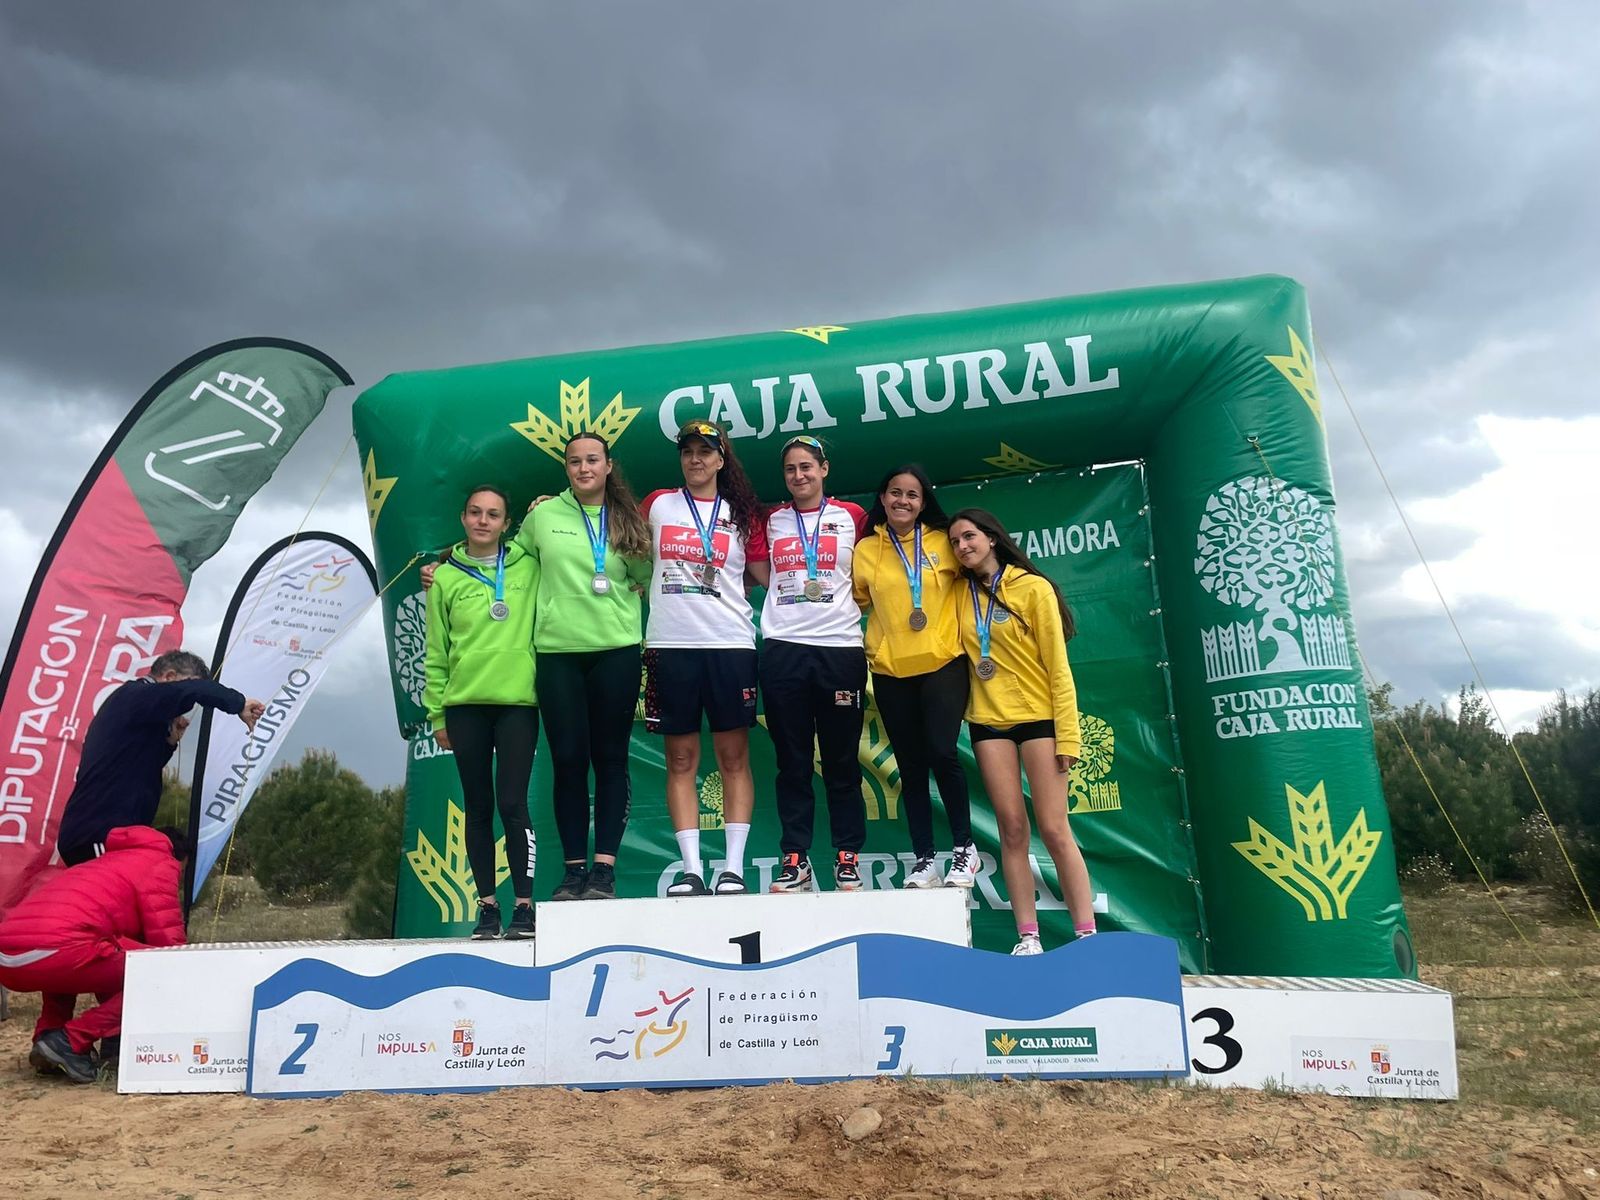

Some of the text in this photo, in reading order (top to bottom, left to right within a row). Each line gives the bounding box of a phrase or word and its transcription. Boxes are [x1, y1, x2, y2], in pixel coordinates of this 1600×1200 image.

[659, 335, 1119, 443] CAJA RURAL
[1212, 683, 1357, 716] FUNDACION
[1216, 707, 1362, 739] CAJA RURAL
[585, 963, 609, 1017] 1
[718, 989, 817, 1001] Federación
[719, 1013, 818, 1025] de Piragüismo
[378, 1032, 401, 1042] NOS
[1019, 1037, 1092, 1049] CAJA RURAL
[1191, 1007, 1243, 1075] 3
[136, 1045, 154, 1053] NOS
[278, 1023, 319, 1076] 2
[719, 1037, 819, 1050] de Castilla y León
[876, 1025, 906, 1070] 3
[476, 1045, 526, 1056] Junta de
[1302, 1049, 1323, 1058] NOS
[211, 1057, 248, 1066] Junta de
[444, 1057, 525, 1071] Castilla y León
[187, 1065, 248, 1076] Castilla y León
[1394, 1067, 1440, 1077] Junta de
[1367, 1075, 1440, 1087] Castilla y León
